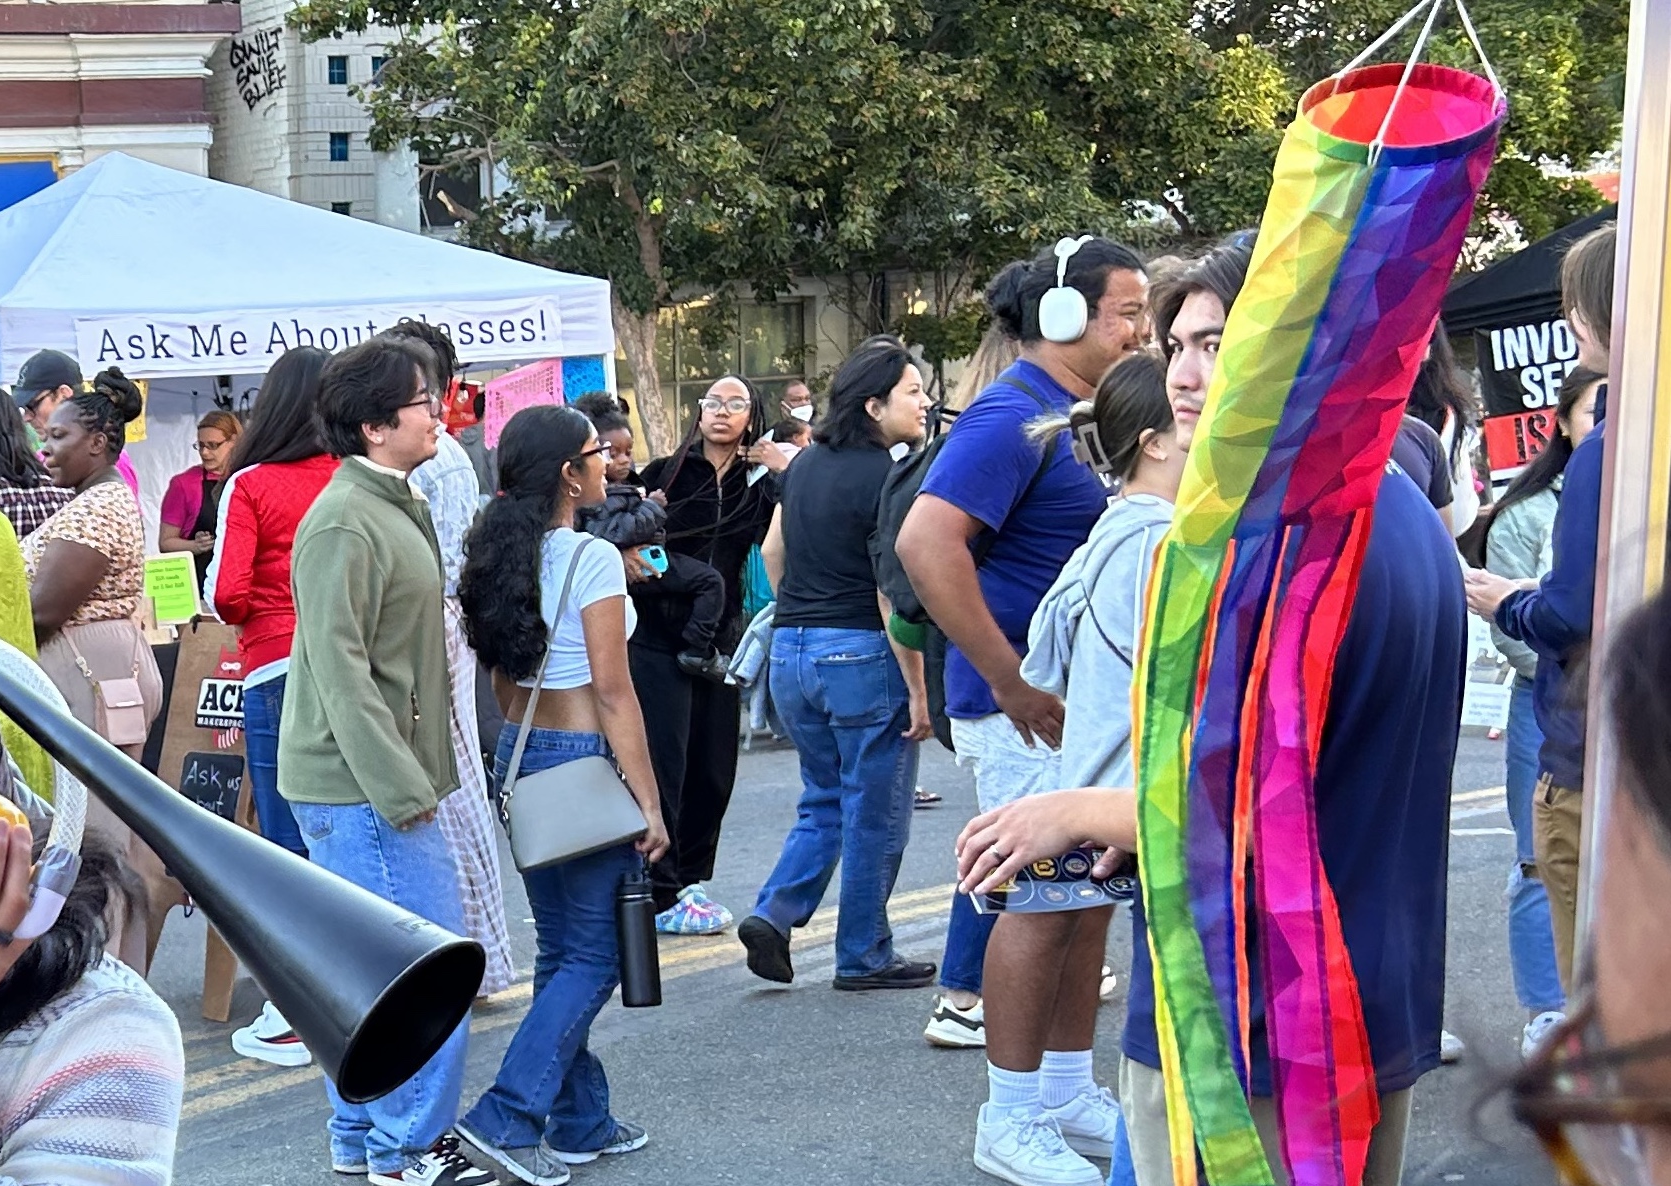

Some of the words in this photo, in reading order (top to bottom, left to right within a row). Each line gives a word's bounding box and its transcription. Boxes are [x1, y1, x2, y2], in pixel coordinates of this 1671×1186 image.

[97, 324, 173, 362] Ask
[187, 323, 248, 357] Me
[265, 318, 378, 355] About
[184, 760, 223, 789] Ask
[227, 777, 242, 791] us
